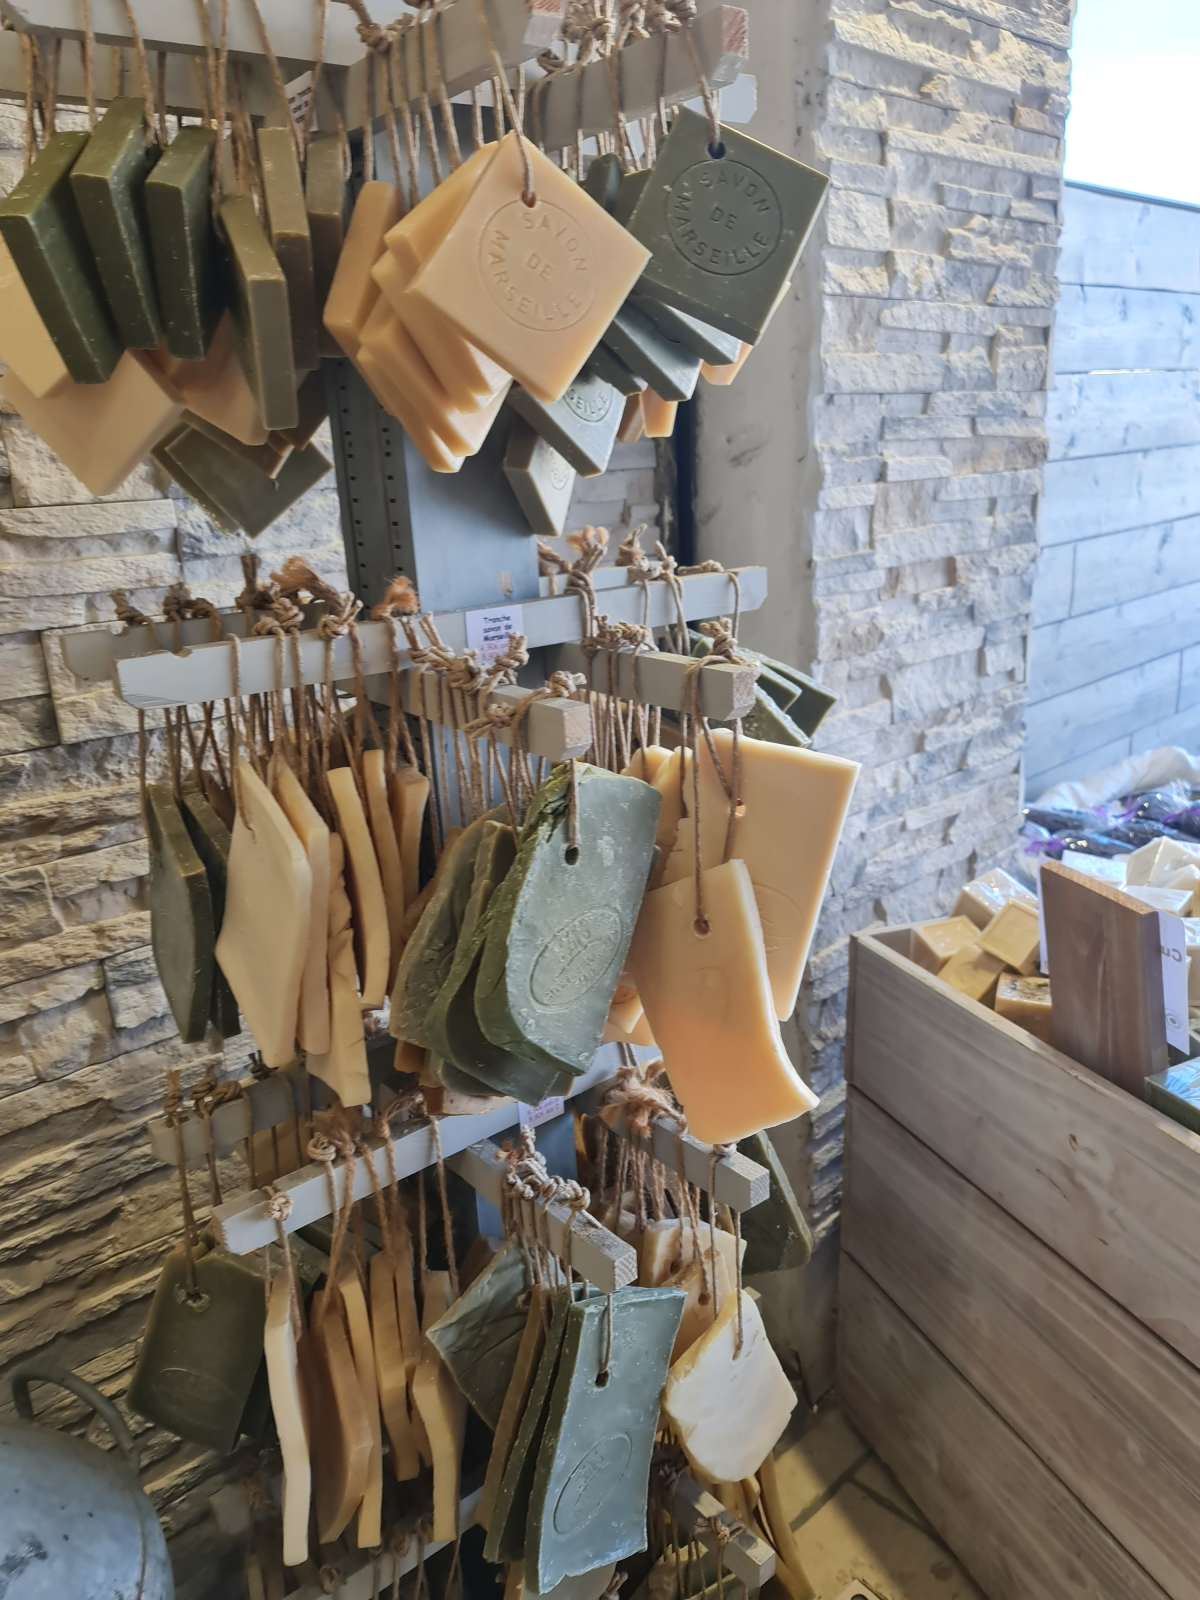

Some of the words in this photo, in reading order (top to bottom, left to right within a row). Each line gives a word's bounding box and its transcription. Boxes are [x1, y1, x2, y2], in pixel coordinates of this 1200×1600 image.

[700, 170, 770, 214] SAVON
[673, 194, 770, 266] MARSEILLE
[709, 206, 739, 230] DE
[521, 211, 588, 271] SAVON
[488, 229, 583, 321] MARSEILLE
[525, 252, 555, 282] DE
[566, 388, 608, 414] SEILLE
